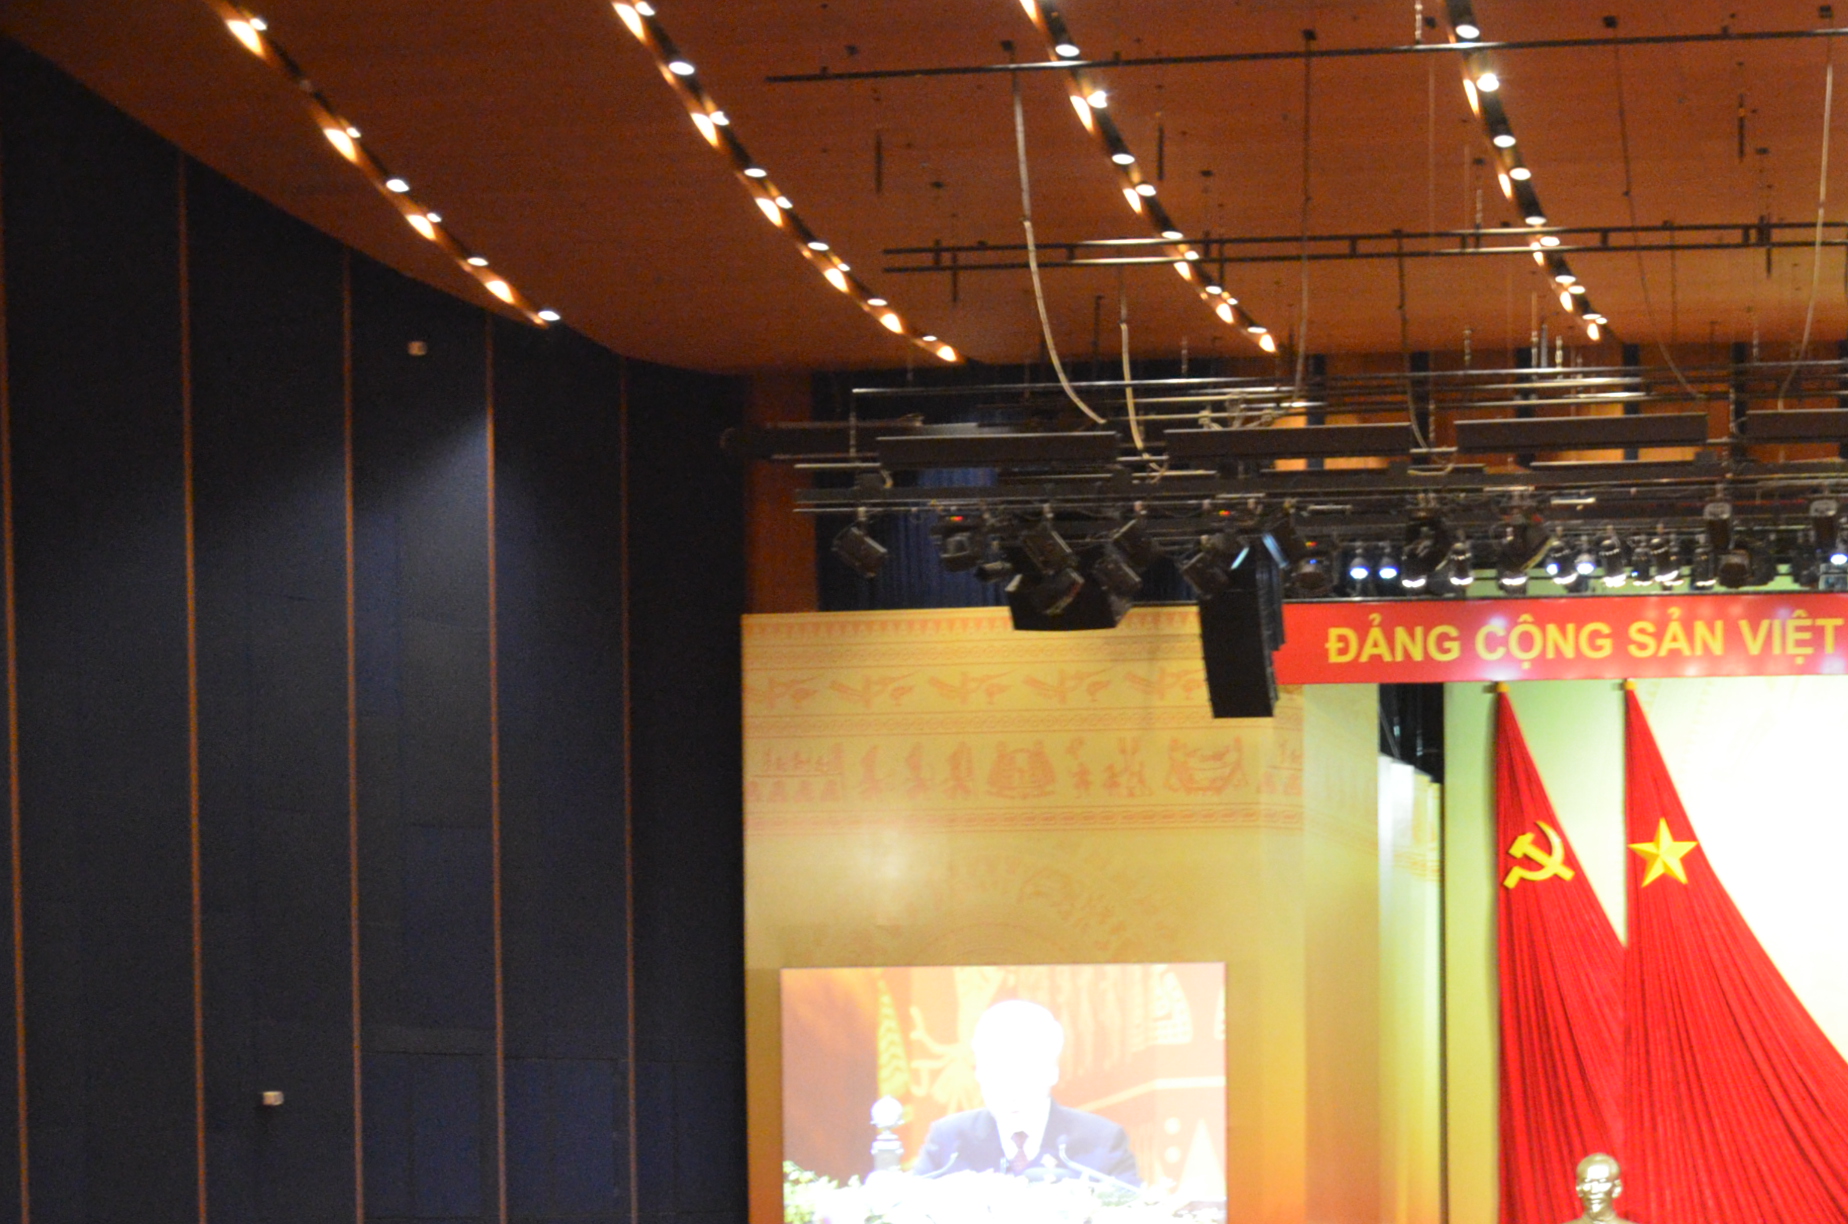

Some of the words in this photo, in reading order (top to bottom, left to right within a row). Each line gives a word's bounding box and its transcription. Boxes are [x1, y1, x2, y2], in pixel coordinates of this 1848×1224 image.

[1325, 613, 1462, 663] ĐẢNG
[1474, 614, 1614, 669] CỘNG
[1627, 607, 1725, 658] SẢN
[1738, 609, 1845, 665] VIỆT
